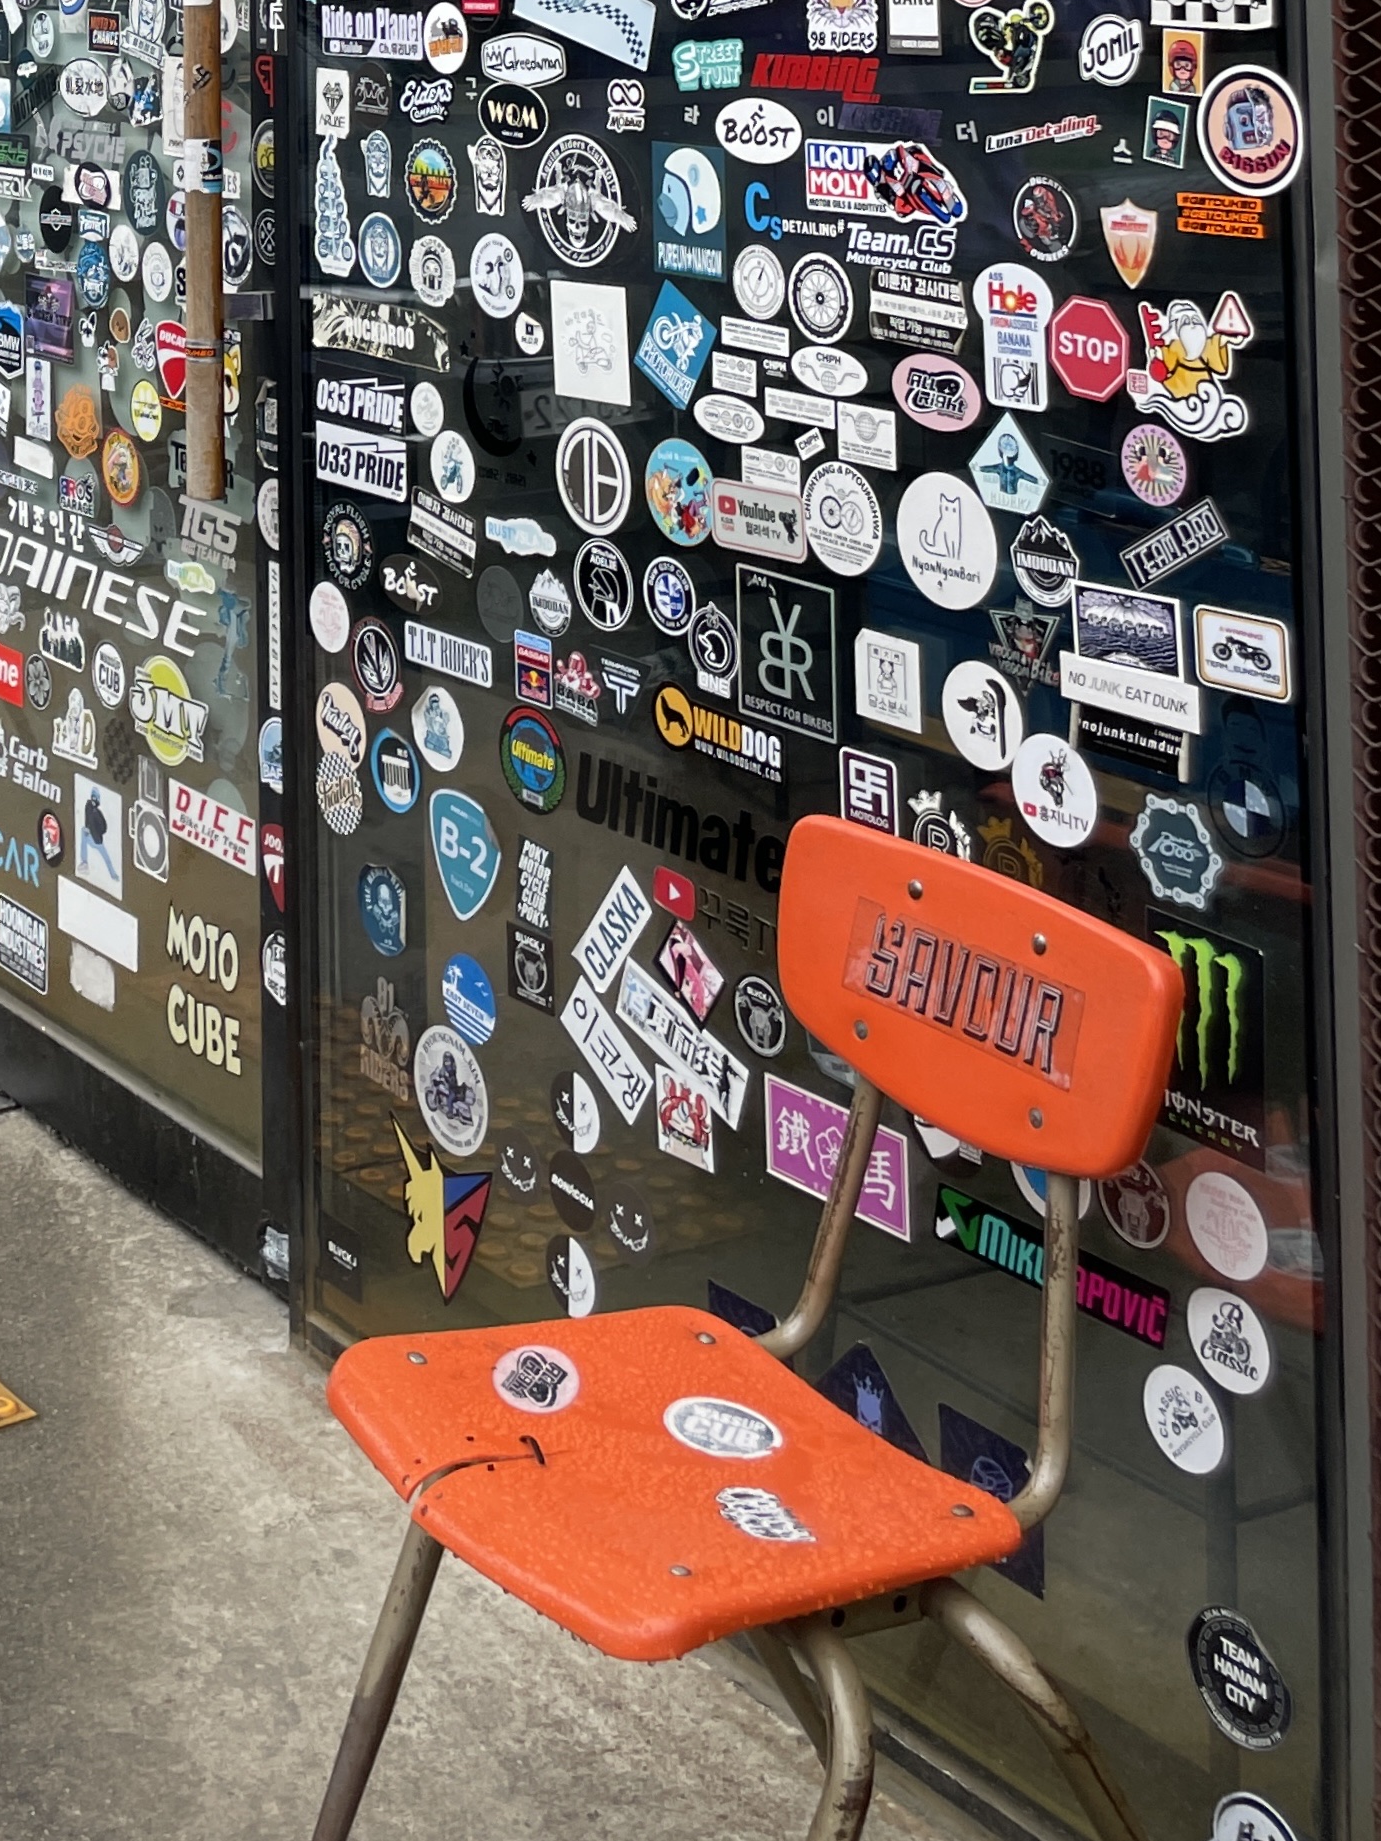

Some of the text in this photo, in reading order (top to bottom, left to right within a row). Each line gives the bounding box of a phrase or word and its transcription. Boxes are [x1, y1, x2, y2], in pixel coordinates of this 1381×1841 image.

[322, 5, 353, 38] Ride
[355, 18, 374, 40] on
[375, 7, 422, 42] Planet
[810, 32, 875, 48] 98 RIDERS
[1084, 32, 1138, 69] JOMIL
[810, 145, 864, 169] LIQUI
[809, 173, 865, 198] MOLY
[809, 198, 830, 207] MOTOR
[846, 251, 952, 275] Motorcycle Club
[998, 332, 1031, 347] BANANA
[1059, 331, 1119, 364] STOP
[317, 379, 403, 430] 033 PRIDE
[318, 441, 404, 493] 033 PRIDE
[59, 477, 93, 501] BROS
[60, 496, 94, 514] GARAGE
[8, 496, 85, 553] 개조인간
[737, 500, 776, 523] YouTube
[1129, 510, 1221, 584] TEAM BRO
[912, 555, 982, 585] NyanNyanBari
[98, 663, 120, 691] CUB
[1068, 671, 1086, 686] NO
[1125, 686, 1151, 705] EAT
[1152, 691, 1188, 714] DUNK
[130, 680, 208, 747] JMT
[745, 695, 833, 735] RESPECT FOR BIKERS
[9, 735, 48, 771] Carb
[13, 763, 61, 803] Salon
[576, 751, 783, 894] Ultimate
[849, 807, 890, 830] MOTOLOG
[1038, 808, 1089, 833] 홍지니TV
[440, 817, 487, 879] B-2
[523, 839, 549, 861] POKY
[518, 857, 552, 880] MOTOR
[521, 872, 550, 894] CYCLE
[0, 896, 46, 944] HOONIGAN
[523, 893, 546, 913] CLUB
[166, 903, 239, 993] MOTO
[584, 882, 645, 980] CLASKA
[866, 912, 1064, 1074] SAVOUR
[167, 983, 241, 1076] CUBE
[1164, 1089, 1259, 1148] ONSTER
[775, 1106, 816, 1172] 鐵
[864, 1150, 896, 1211] 馬
[1200, 1339, 1258, 1381] Classic
[682, 1417, 761, 1450] CUB
[1220, 1635, 1260, 1675] TEAM
[1214, 1654, 1267, 1700] HANAM
[1225, 1682, 1256, 1714] CITY
